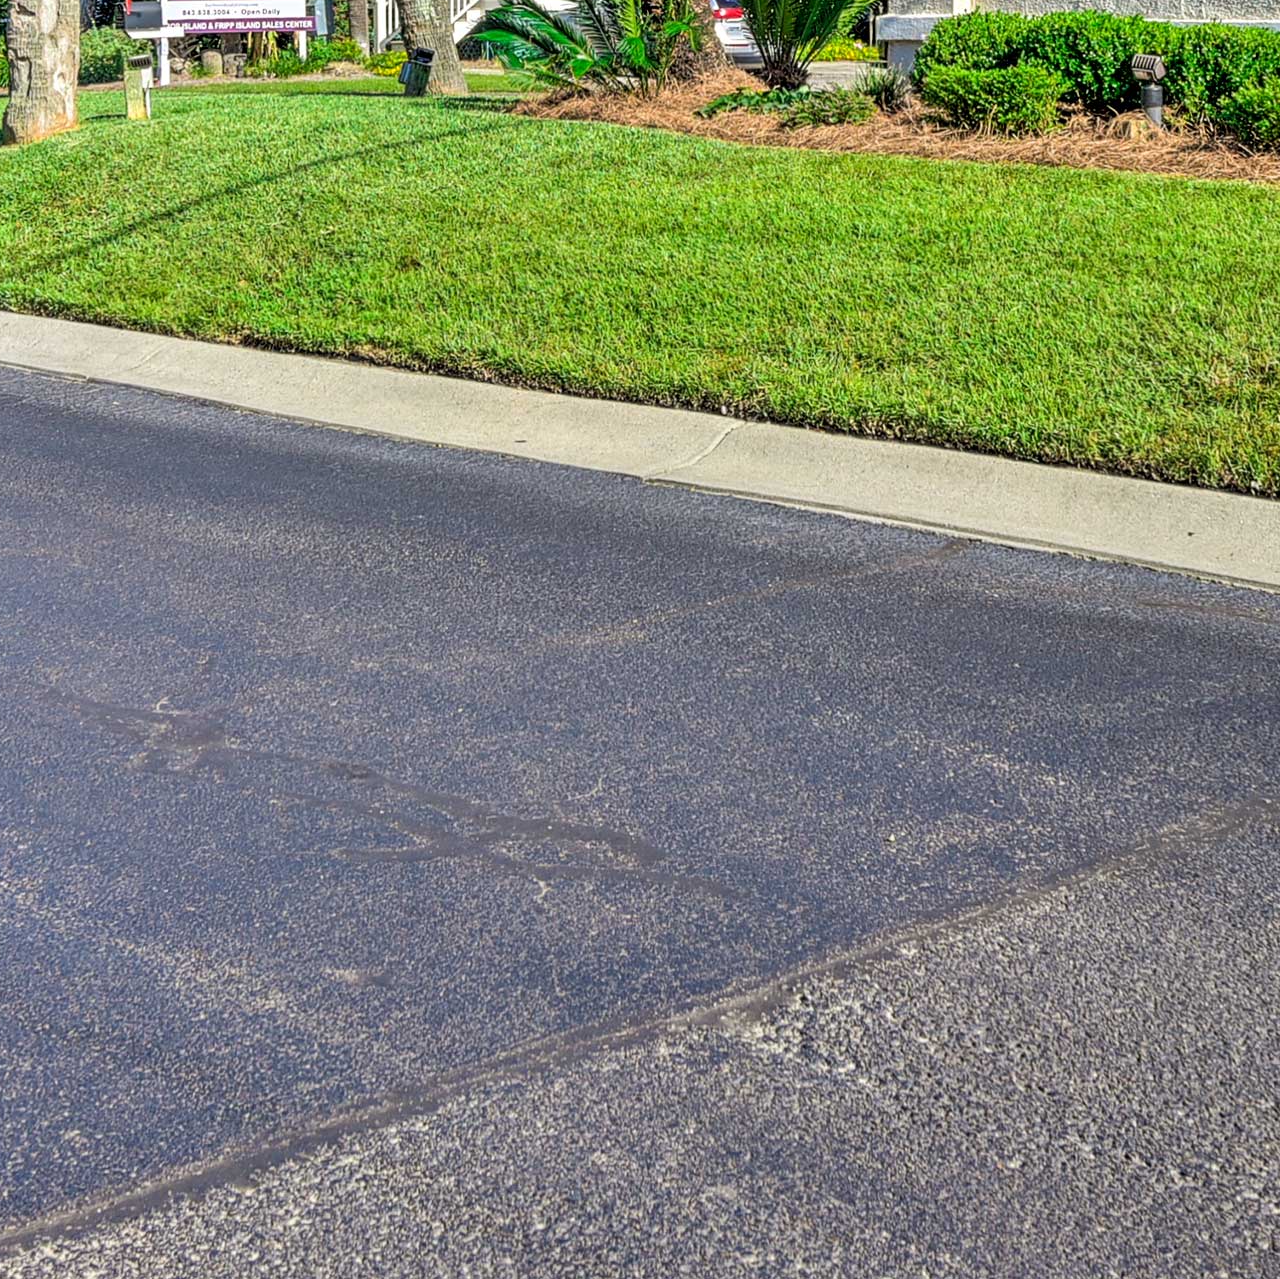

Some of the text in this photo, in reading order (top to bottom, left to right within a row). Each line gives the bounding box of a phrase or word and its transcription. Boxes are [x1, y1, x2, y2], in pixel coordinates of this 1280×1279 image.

[214, 21, 235, 30] FRIPP
[235, 21, 261, 29] ISLAND
[261, 20, 284, 28] SALES
[285, 20, 313, 28] CENTER
